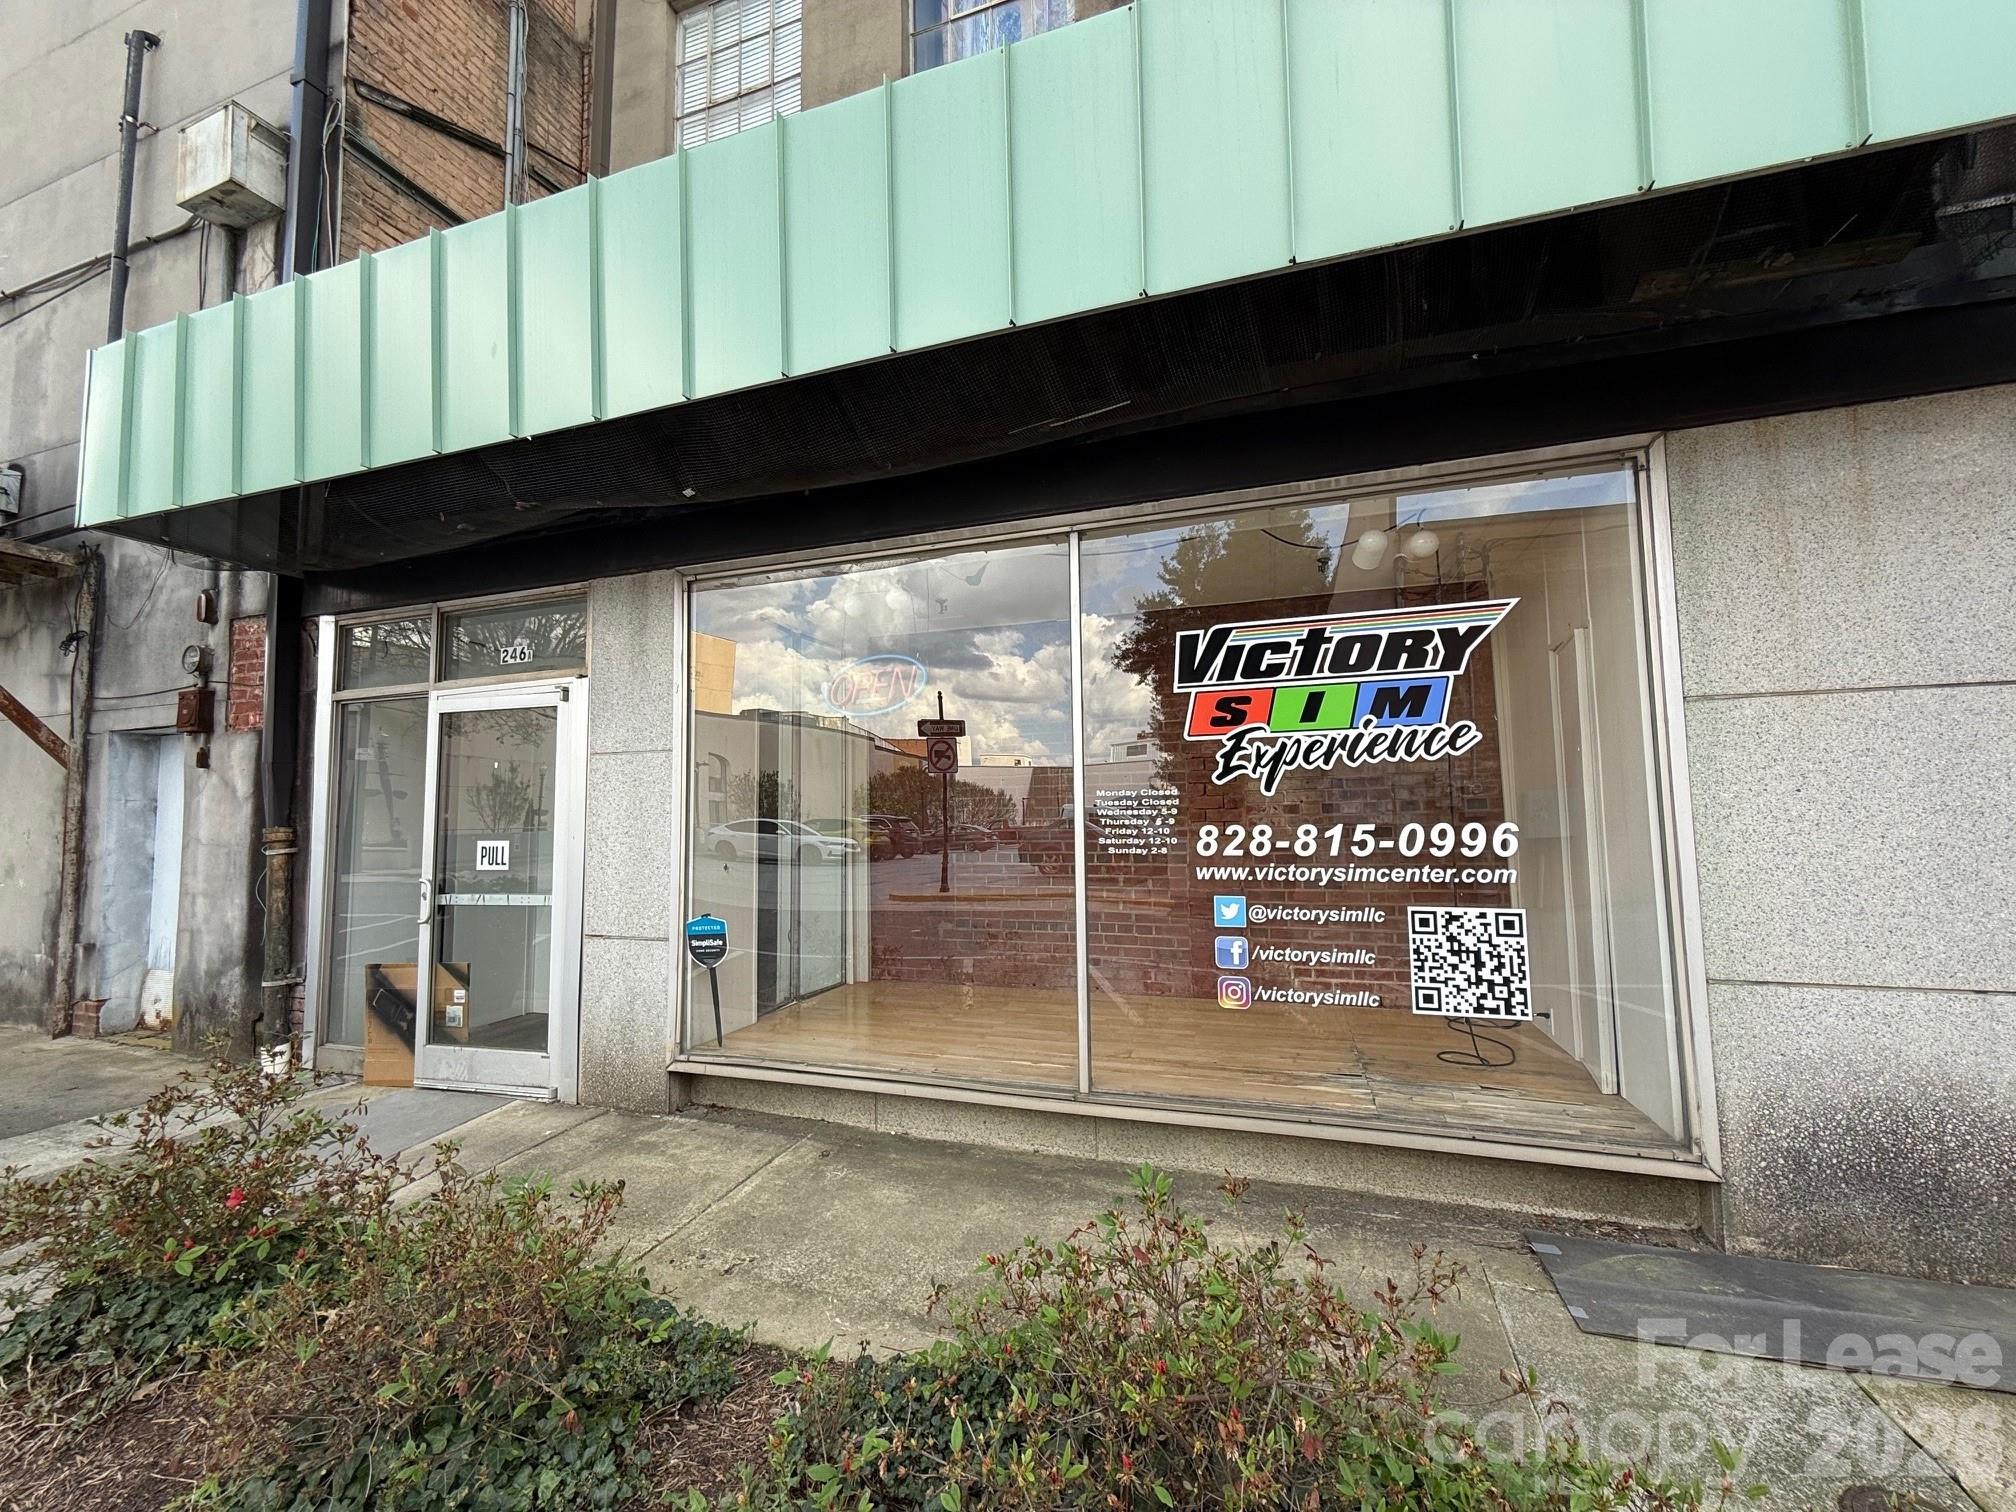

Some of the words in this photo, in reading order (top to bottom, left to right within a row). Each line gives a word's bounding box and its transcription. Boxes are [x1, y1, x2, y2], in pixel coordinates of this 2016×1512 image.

[831, 665, 918, 706] OPEN
[1210, 685, 1431, 727] SIM
[1214, 718, 1478, 794] Experience
[1096, 790, 1138, 798] Monday
[1140, 788, 1178, 796] Closed
[1095, 799, 1139, 808] Tuesday
[1141, 798, 1180, 806] Closed
[1097, 808, 1158, 817] Wednesday
[1100, 818, 1149, 827] Thursday
[1105, 828, 1139, 836] Friday
[1098, 837, 1146, 846] Saturday
[1196, 822, 1520, 858] 828-815-0996
[481, 846, 507, 866] PULL
[1108, 847, 1148, 856] Sunday
[1195, 863, 1518, 885] www.victorysimcenter.com
[1249, 905, 1386, 924] @victorysimllc
[691, 939, 723, 947] SimpliSafe
[1252, 946, 1376, 966] /victorysimllc
[1254, 986, 1380, 1008] /victorysimllc
